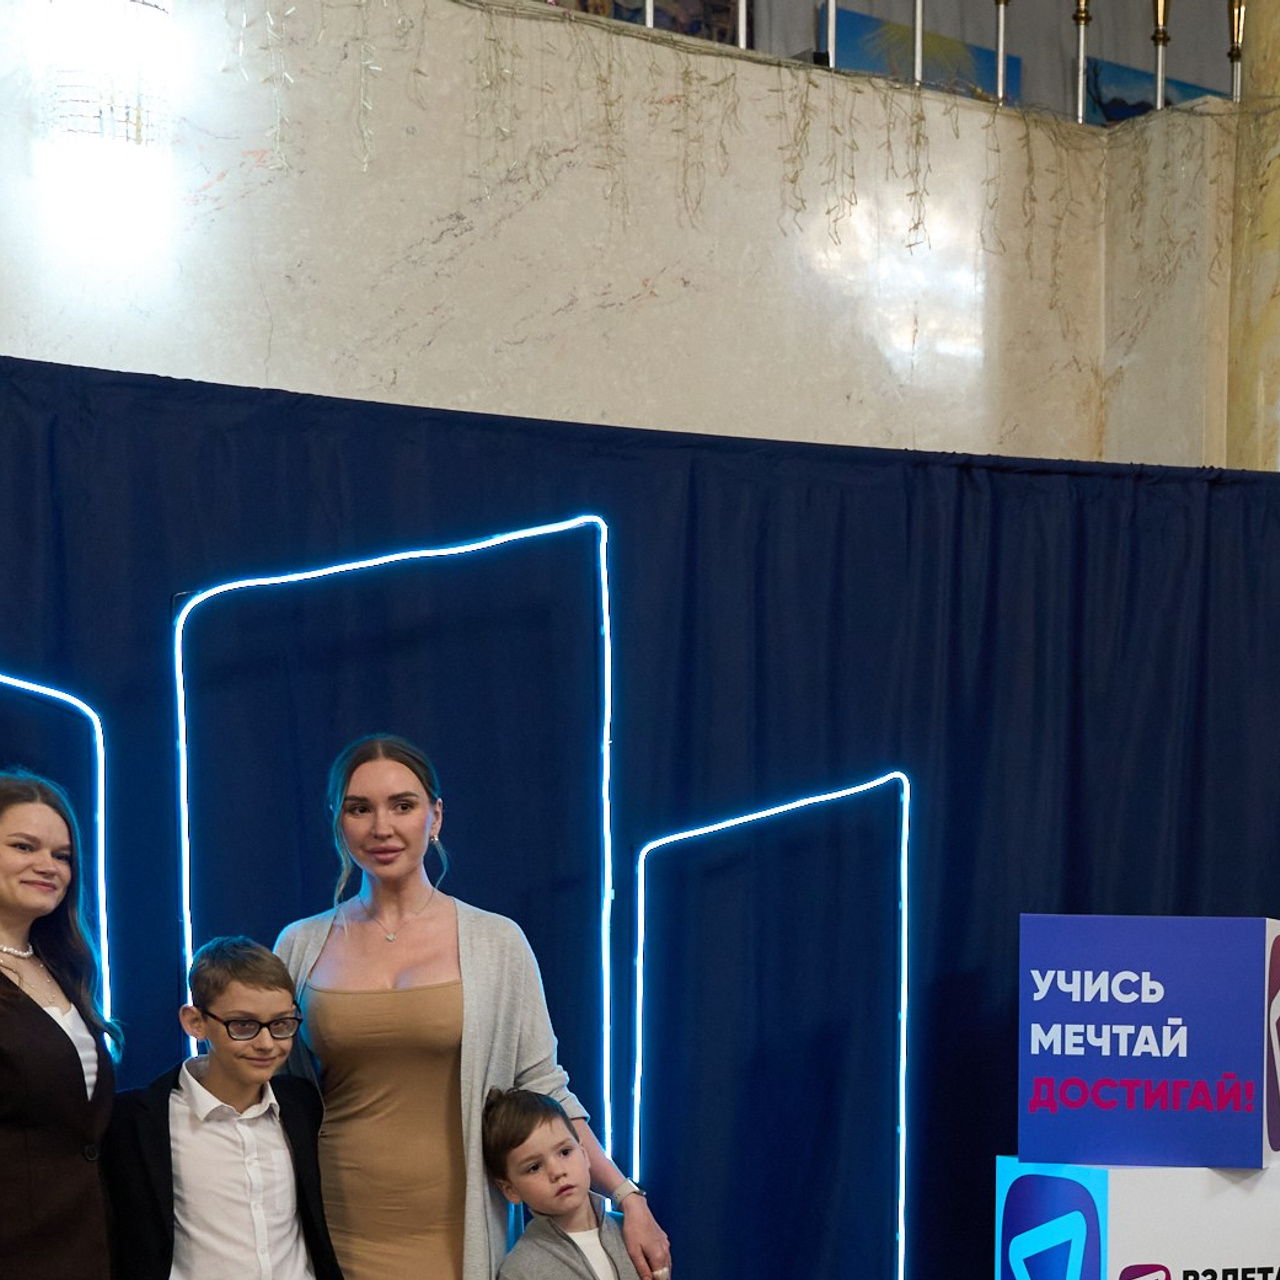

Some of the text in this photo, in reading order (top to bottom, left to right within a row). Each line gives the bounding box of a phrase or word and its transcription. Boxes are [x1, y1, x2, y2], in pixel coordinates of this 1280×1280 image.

[1030, 969, 1165, 1004] УЧИСЬ
[1030, 1017, 1188, 1058] МЕЧТАЙ
[1028, 1072, 1255, 1114] ДОСТИГАЙ!
